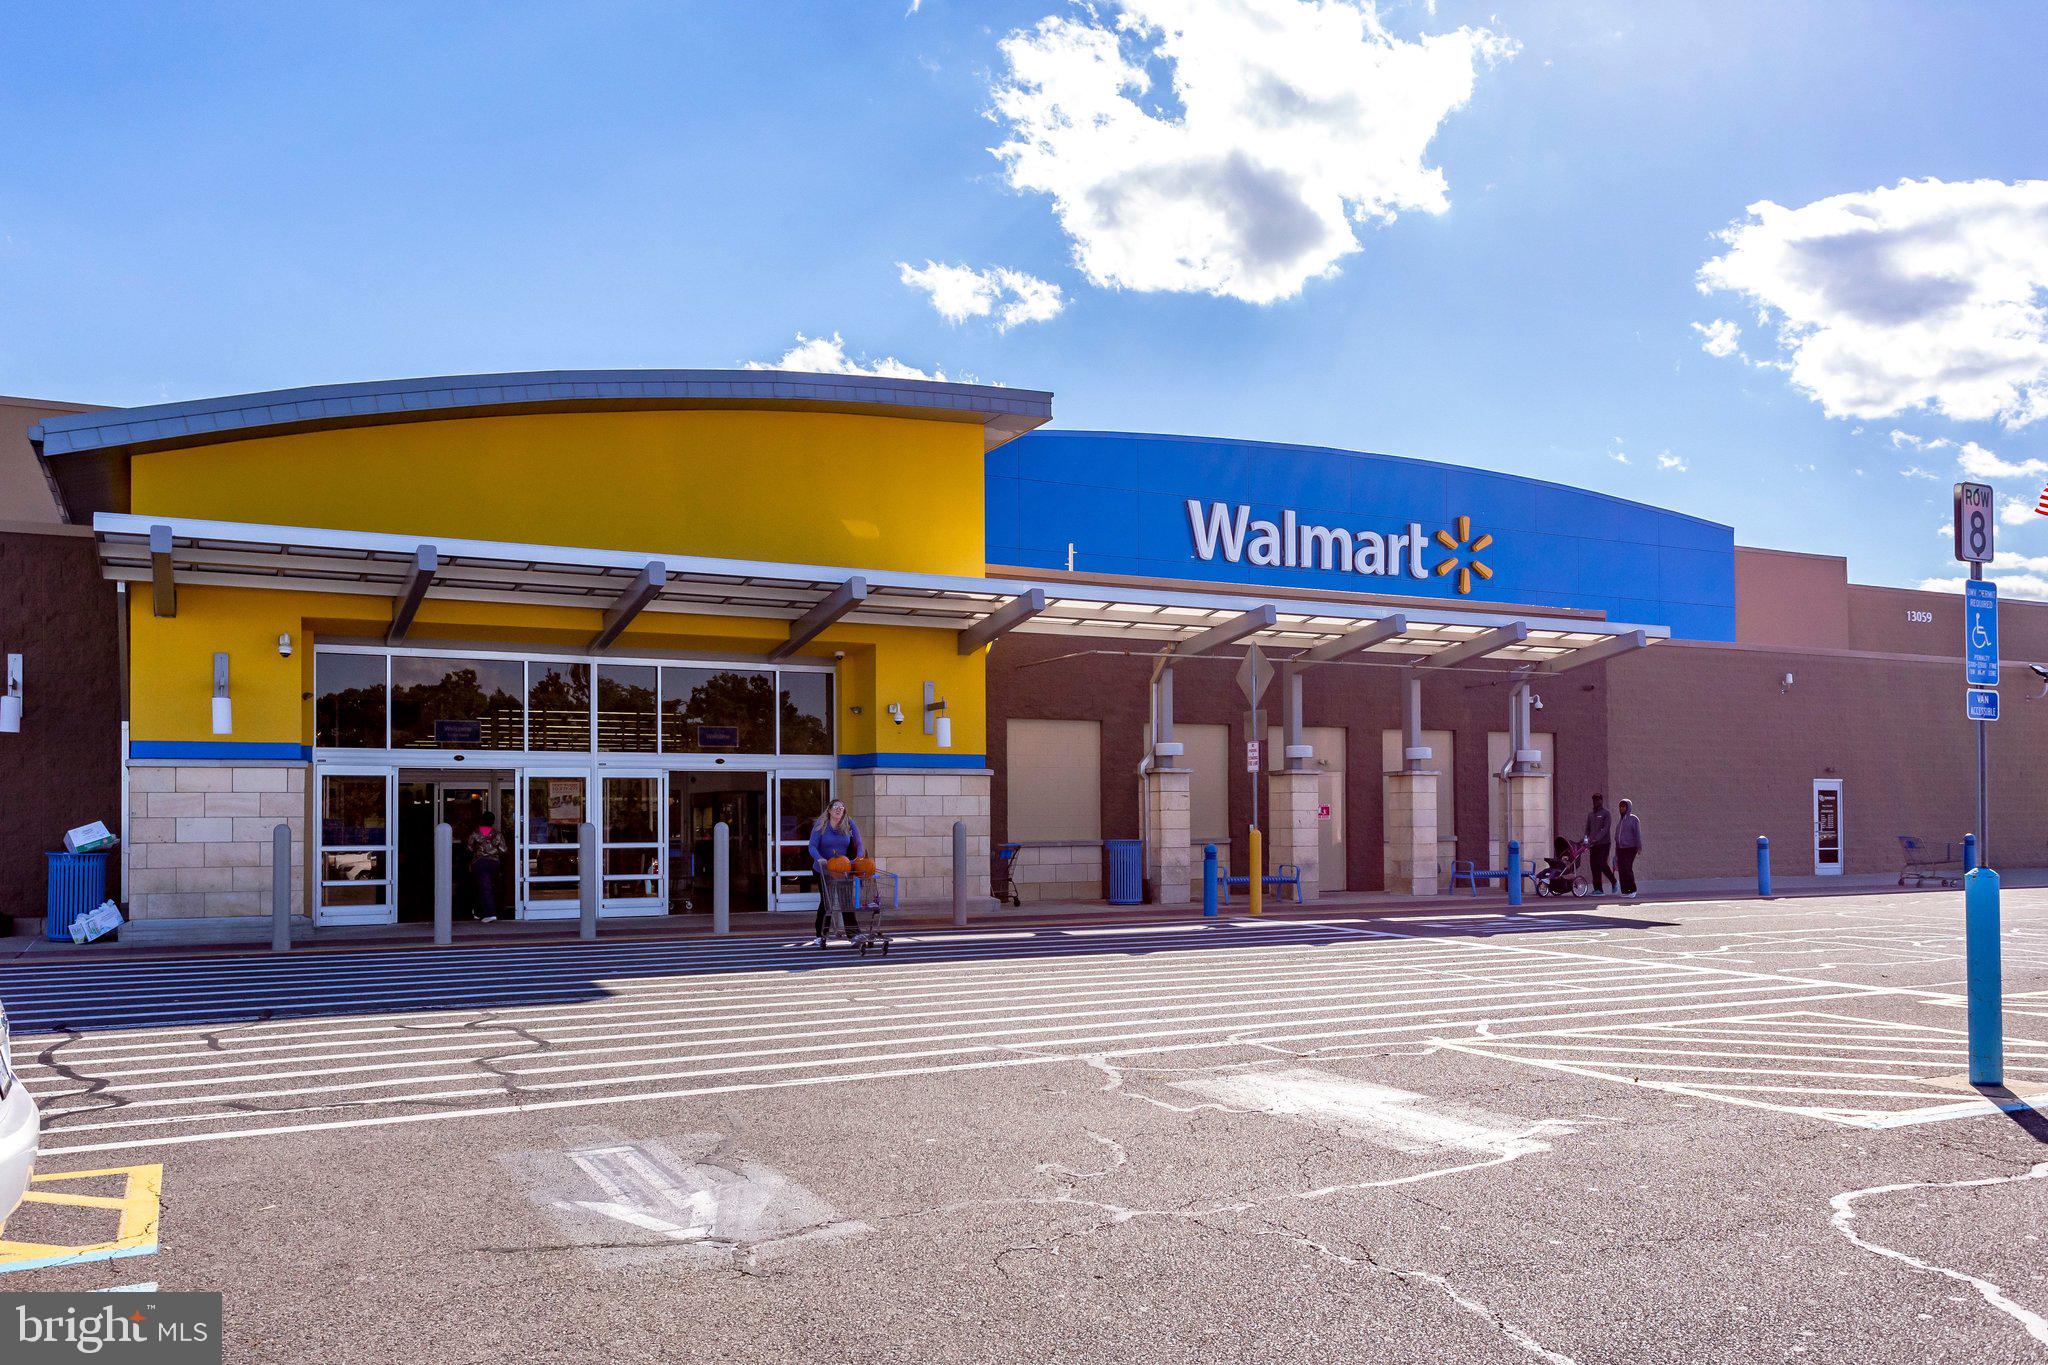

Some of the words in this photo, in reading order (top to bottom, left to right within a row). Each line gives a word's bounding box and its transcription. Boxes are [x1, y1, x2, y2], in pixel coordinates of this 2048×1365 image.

[1965, 488, 1990, 507] ROW
[1187, 499, 1429, 579] Walmart
[1970, 511, 1986, 554] 8
[1970, 599, 1993, 609] REQUIRED
[1906, 610, 1932, 623] 13059
[1976, 694, 1989, 704] VAN
[1970, 706, 1996, 717] ACCESSIBLE
